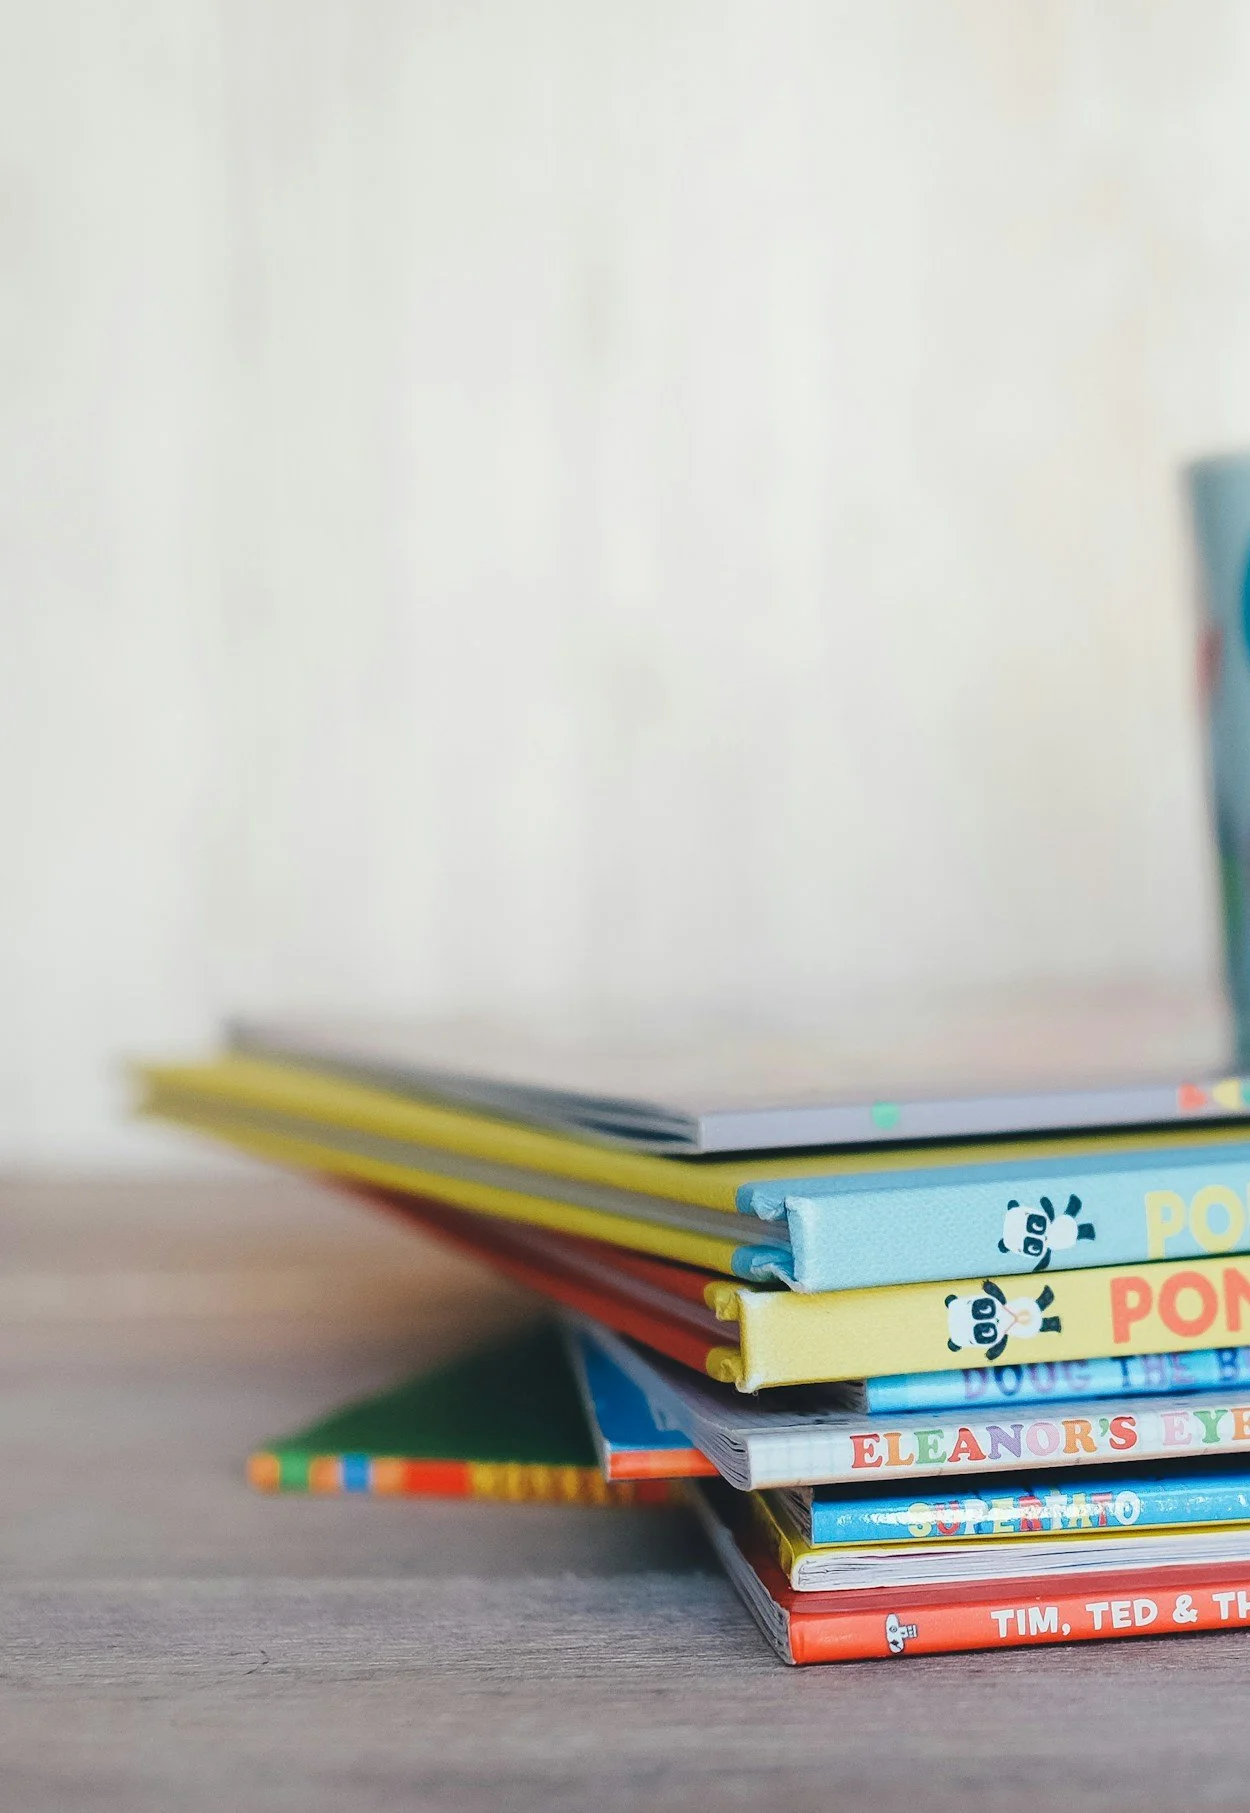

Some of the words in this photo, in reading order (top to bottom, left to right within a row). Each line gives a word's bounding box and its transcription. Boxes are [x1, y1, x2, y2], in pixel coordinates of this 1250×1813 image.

[962, 1360, 1088, 1399] DOUG
[1113, 1350, 1195, 1388] THE
[850, 1416, 1137, 1469] ELEANOR'S
[990, 1606, 1071, 1638] TIM,
[1085, 1599, 1158, 1631] TED
[1172, 1594, 1198, 1624] &
